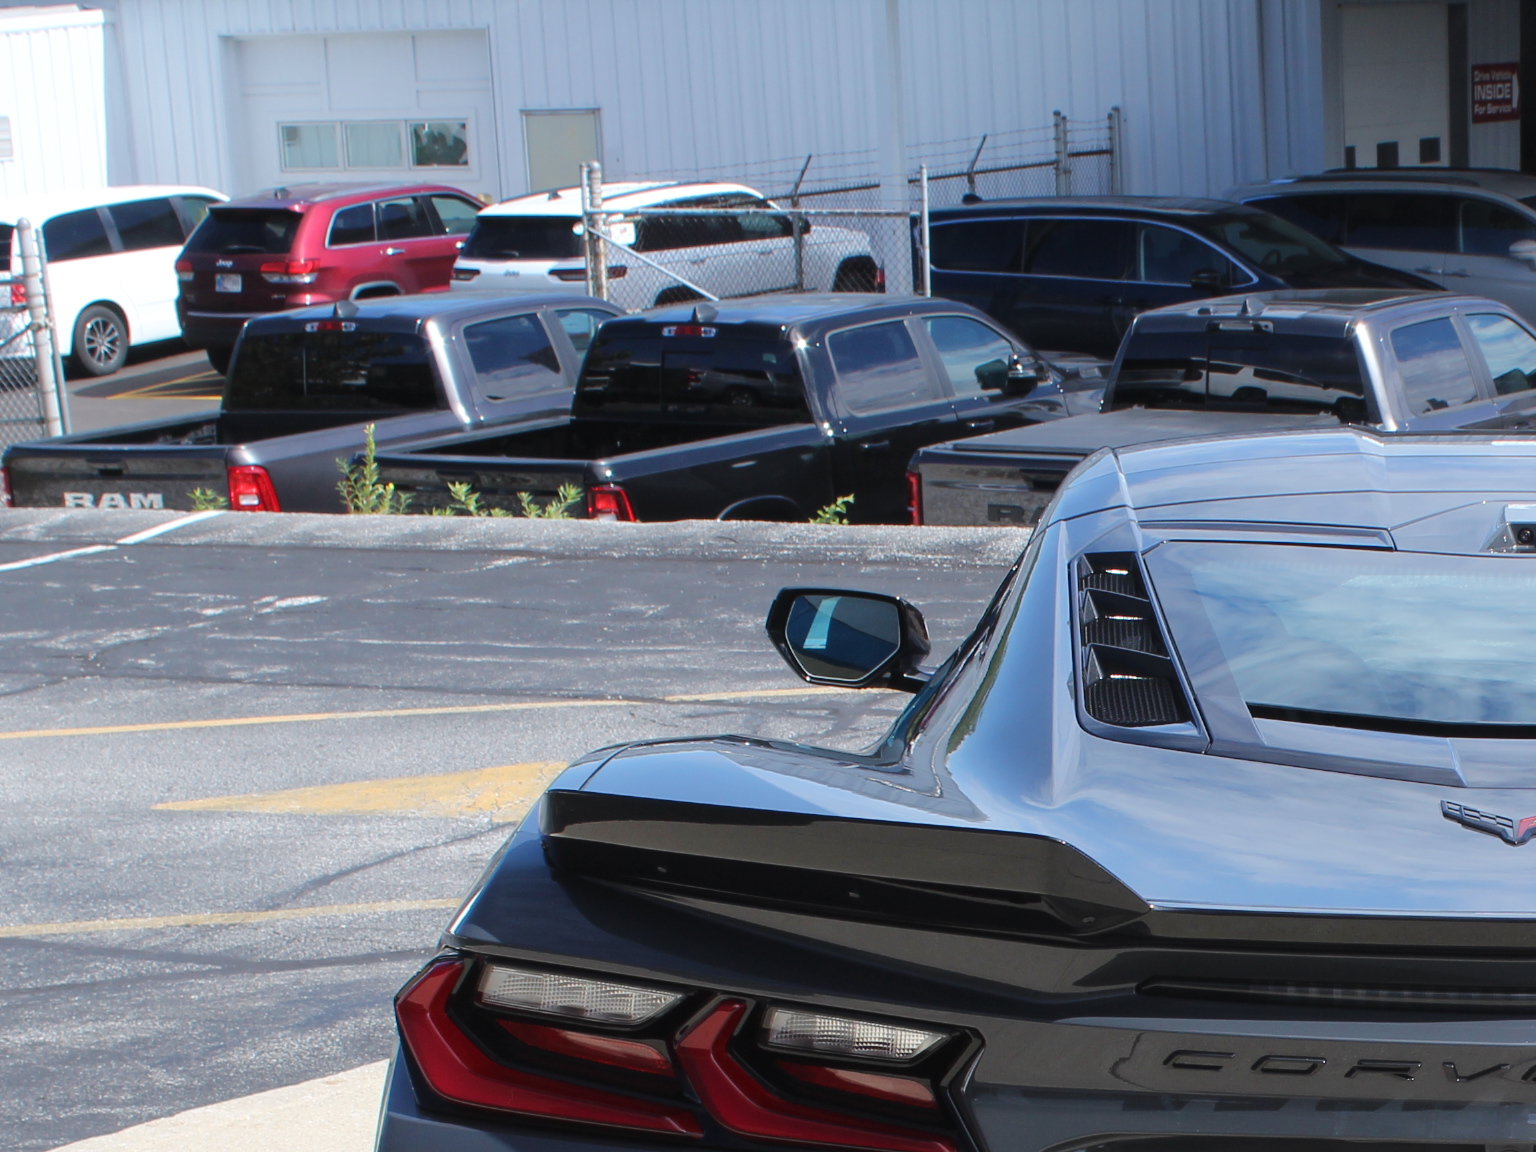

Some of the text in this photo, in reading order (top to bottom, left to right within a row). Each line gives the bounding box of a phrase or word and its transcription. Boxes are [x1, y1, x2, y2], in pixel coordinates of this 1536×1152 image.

[1474, 83, 1511, 101] INSIDE
[1474, 103, 1512, 115] For Service
[63, 492, 164, 509] RAM
